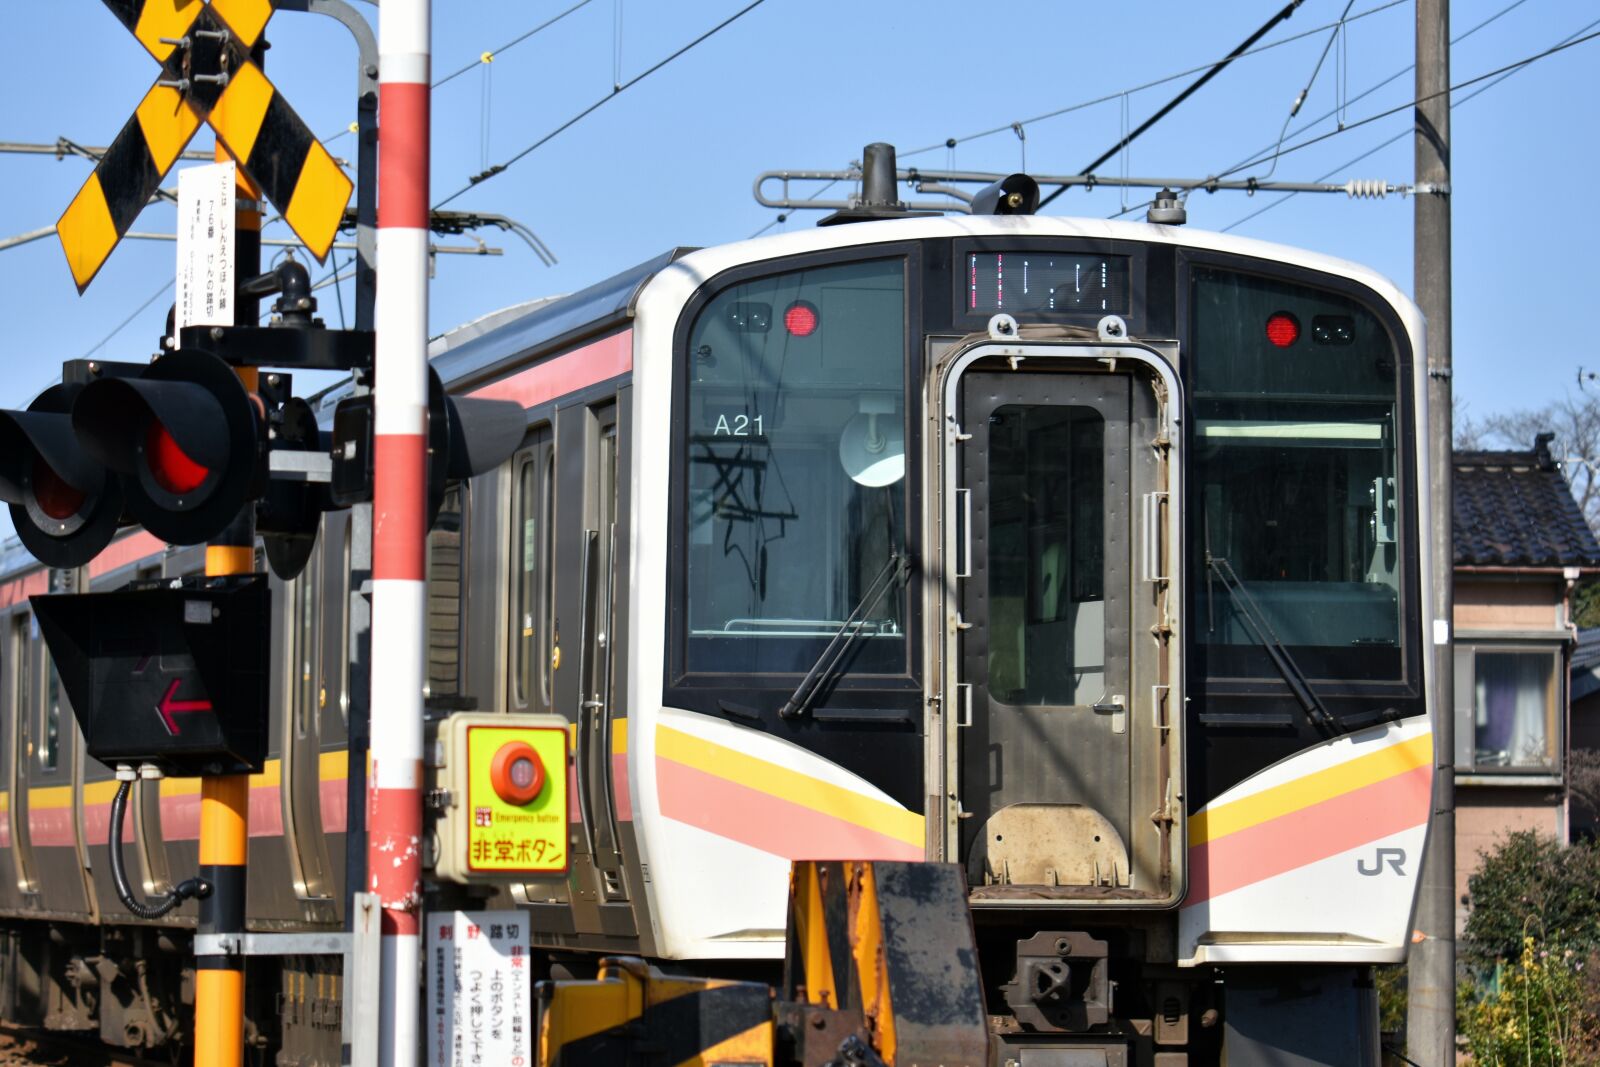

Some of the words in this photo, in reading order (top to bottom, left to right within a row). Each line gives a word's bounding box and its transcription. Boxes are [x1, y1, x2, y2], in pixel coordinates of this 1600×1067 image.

[713, 414, 763, 436] A21
[473, 838, 563, 864] 非常ボタン
[1357, 847, 1408, 877] JR
[470, 970, 483, 1067] つよく押して下さ
[490, 969, 504, 1040] 上のボタンを
